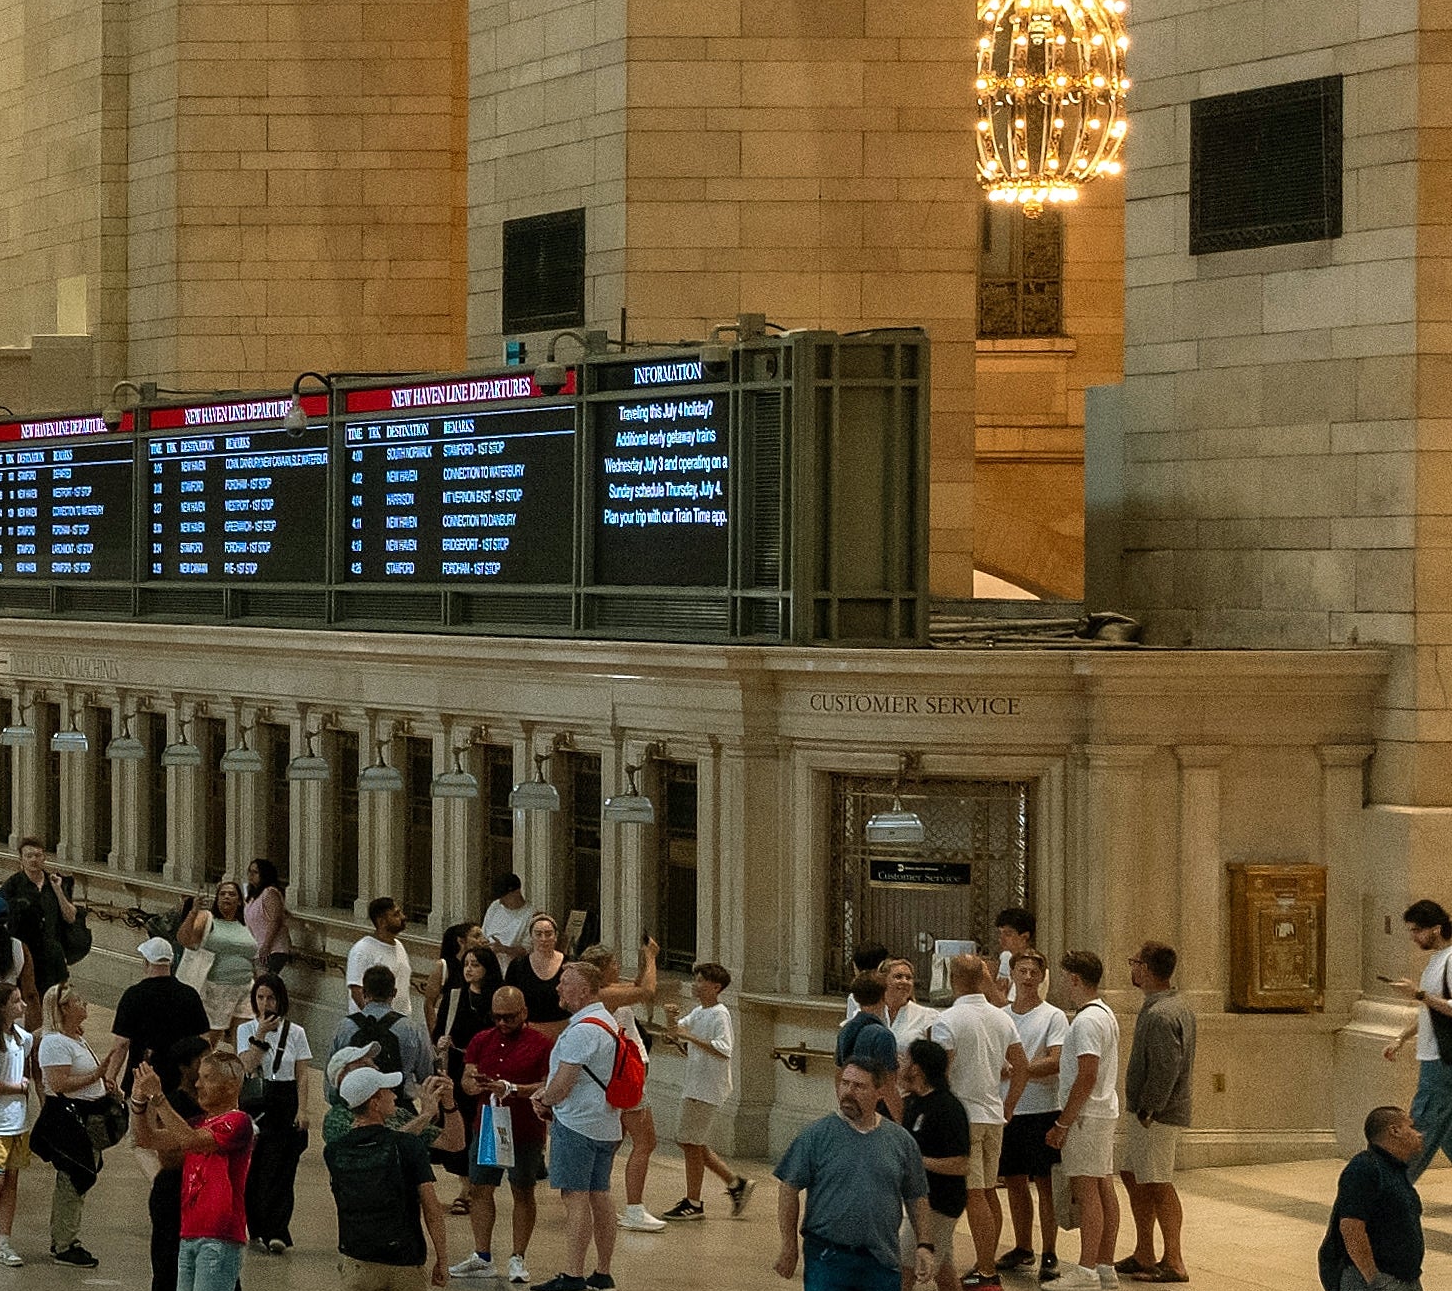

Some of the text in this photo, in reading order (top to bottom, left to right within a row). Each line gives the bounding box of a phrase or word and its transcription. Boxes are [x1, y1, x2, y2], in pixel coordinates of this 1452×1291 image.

[633, 361, 702, 385] INFORMATION
[391, 377, 531, 408] NEW HAVEN LINE DEPARTURES
[185, 403, 246, 425] NEW HAVEN LINE
[649, 403, 663, 419] this
[663, 402, 677, 422] July
[683, 399, 714, 419] holiday?
[20, 419, 70, 440] NEW HAVEN LINE
[347, 418, 475, 441] TIME TRK DESTINATION REMARKS
[615, 430, 649, 448] Additional
[649, 430, 666, 449] early
[696, 427, 717, 443] trains
[443, 466, 479, 481] CONNECTION
[604, 456, 643, 475] Wednesday
[643, 456, 658, 475] July
[664, 454, 678, 471] and
[678, 454, 711, 473] operating
[711, 455, 722, 469] on
[608, 483, 635, 502] Sunday
[635, 481, 665, 498] schedule
[665, 480, 699, 501] Thursday,
[699, 479, 714, 500] July
[442, 514, 480, 528] CONNECTION
[603, 506, 728, 528] Plan your trip with our Train Time app.
[809, 693, 1021, 716] CUSTOMER SERVICE
[877, 870, 960, 883] Customer Service
